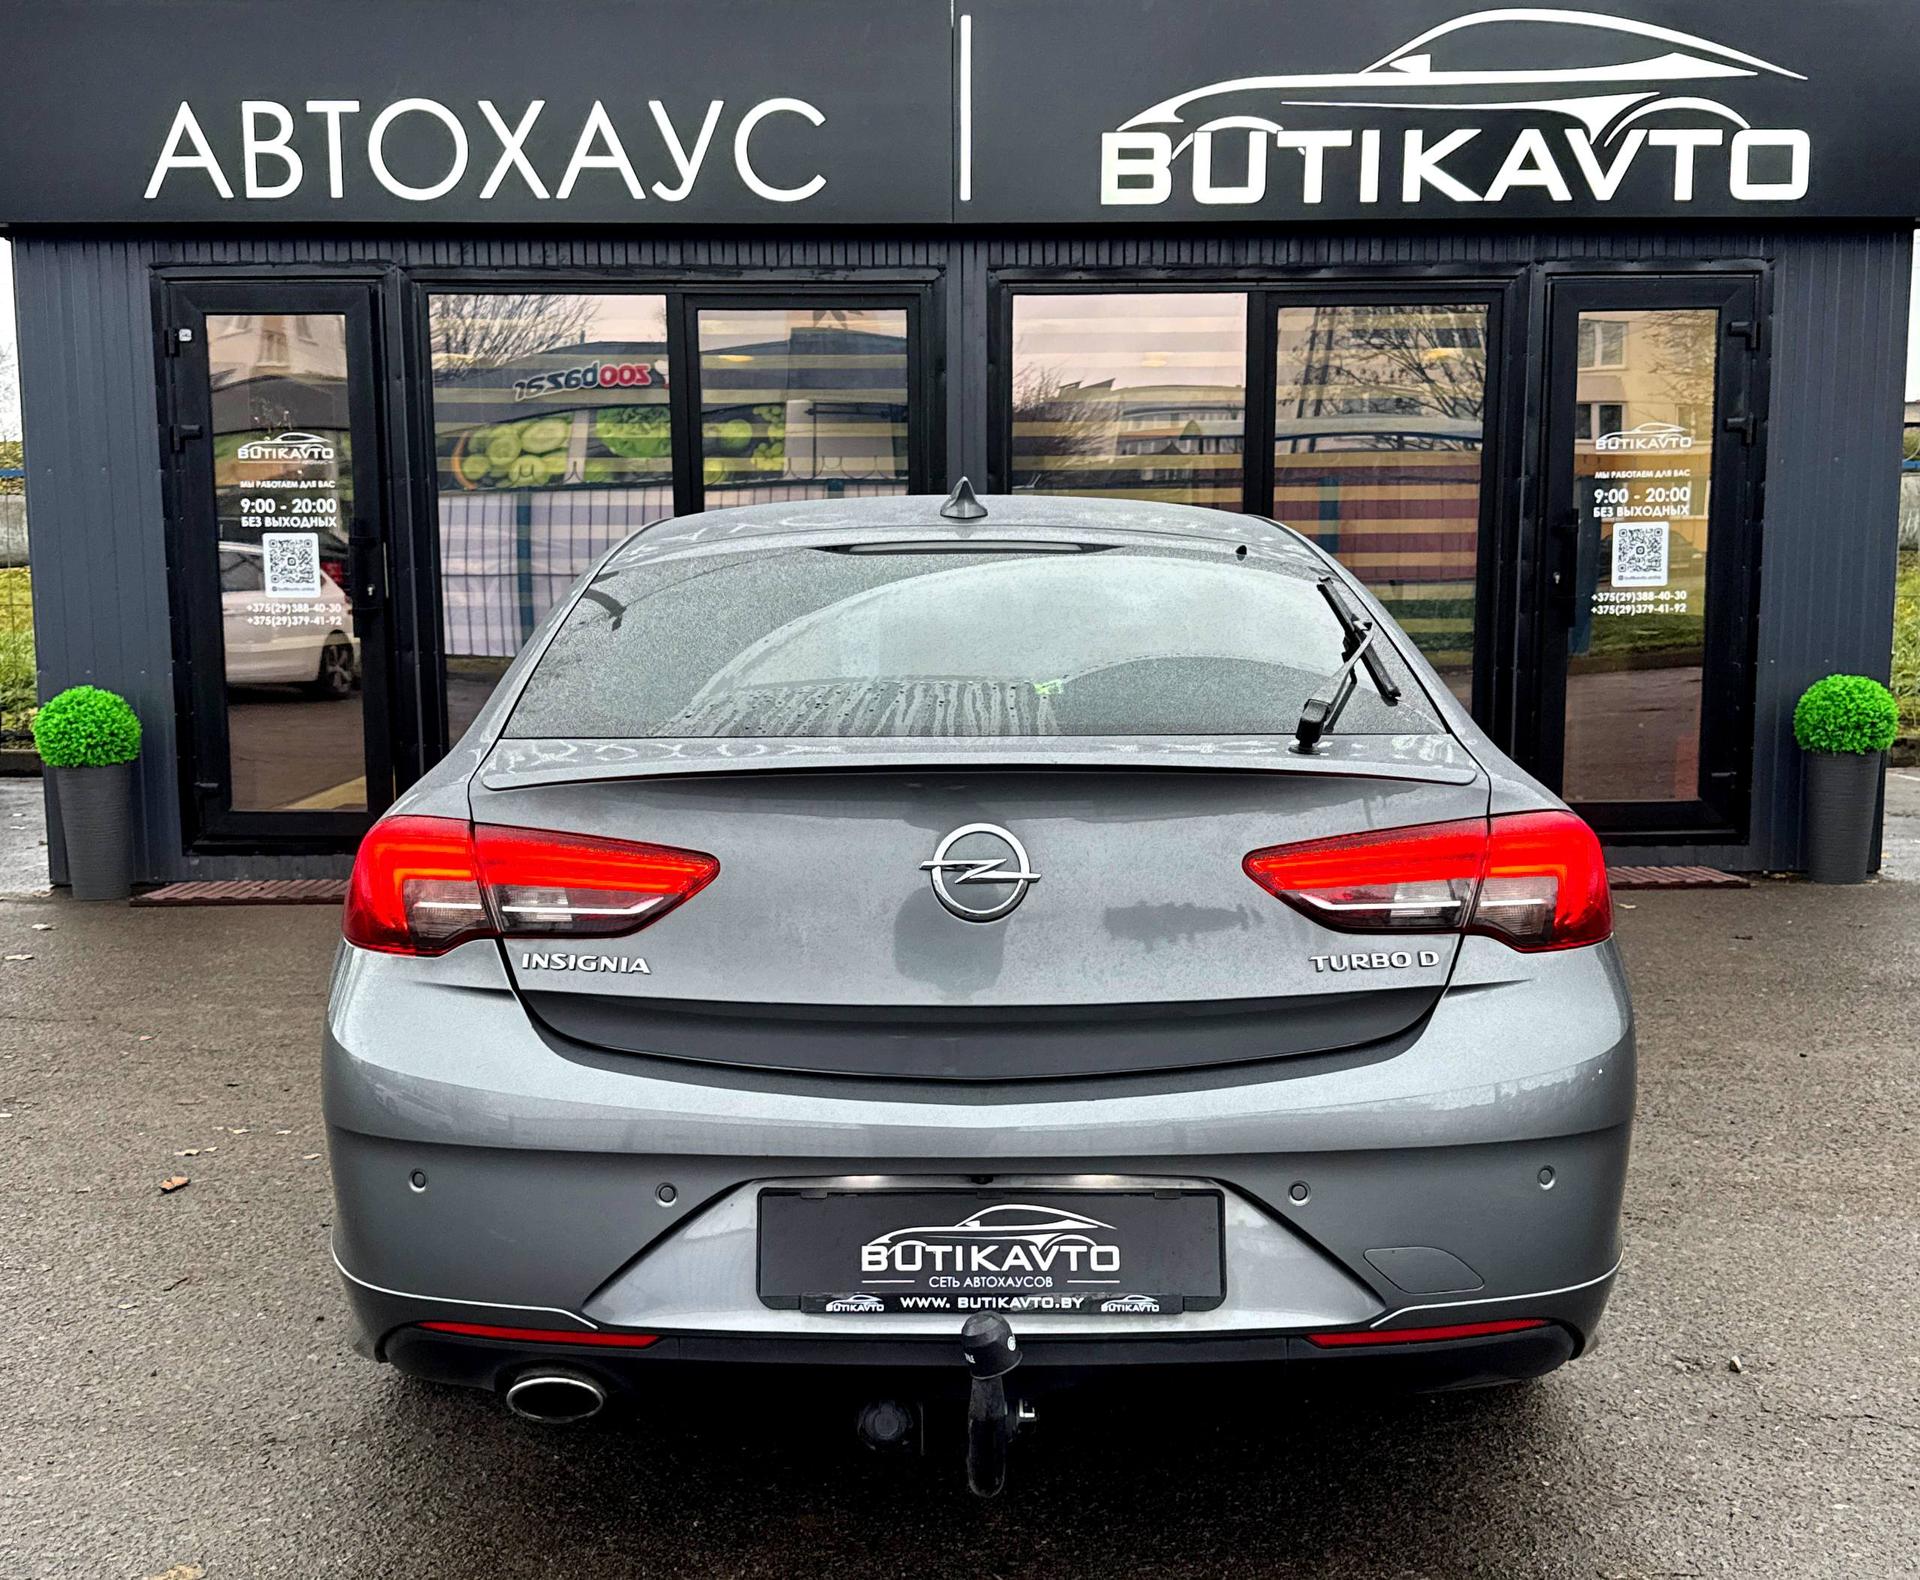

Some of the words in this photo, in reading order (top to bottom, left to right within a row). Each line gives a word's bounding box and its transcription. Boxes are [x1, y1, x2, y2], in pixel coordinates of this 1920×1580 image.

[144, 97, 827, 202] АВТОХАУС
[1101, 128, 1810, 205] BUTIKAVTO
[1596, 437, 1692, 450] BUTIKAVTO
[237, 448, 334, 460] BUTIKAVTO
[1611, 470, 1653, 478] РАБОТАЕМ
[1655, 470, 1671, 478] ДЛЯ
[1673, 469, 1691, 477] ВАС
[256, 481, 298, 489] РАБОТАЕМ
[300, 481, 317, 489] ДЛЯ
[318, 480, 336, 488] ВАС
[1594, 489, 1628, 504] 9:00
[1645, 487, 1691, 502] 20:00
[241, 499, 276, 513] 9:00
[292, 499, 336, 513] 20:00
[1593, 507, 1613, 518] БЕЗ
[1617, 505, 1690, 517] ВЫХОДНЫХ
[241, 517, 262, 527] БЕЗ
[264, 516, 336, 528] ВЫХОДНЫХ
[1591, 591, 1687, 604] +375(29)388-40-30
[1591, 604, 1687, 615] +375(29)379-41-92
[521, 953, 651, 974] INSIGNIA
[1310, 951, 1412, 972] TURBO
[1417, 950, 1440, 967] D
[861, 1244, 1121, 1272] BUTIKAVTO
[929, 1275, 960, 1288] СЕТЬ
[964, 1275, 1054, 1288] АВТОХАУСОВ
[825, 1303, 885, 1312] BUTIKAVTO
[900, 1297, 950, 1308] WWW.
[957, 1296, 1085, 1309] BUTIKAVTO.BY
[1101, 1303, 1160, 1312] BUTIKAVTO
